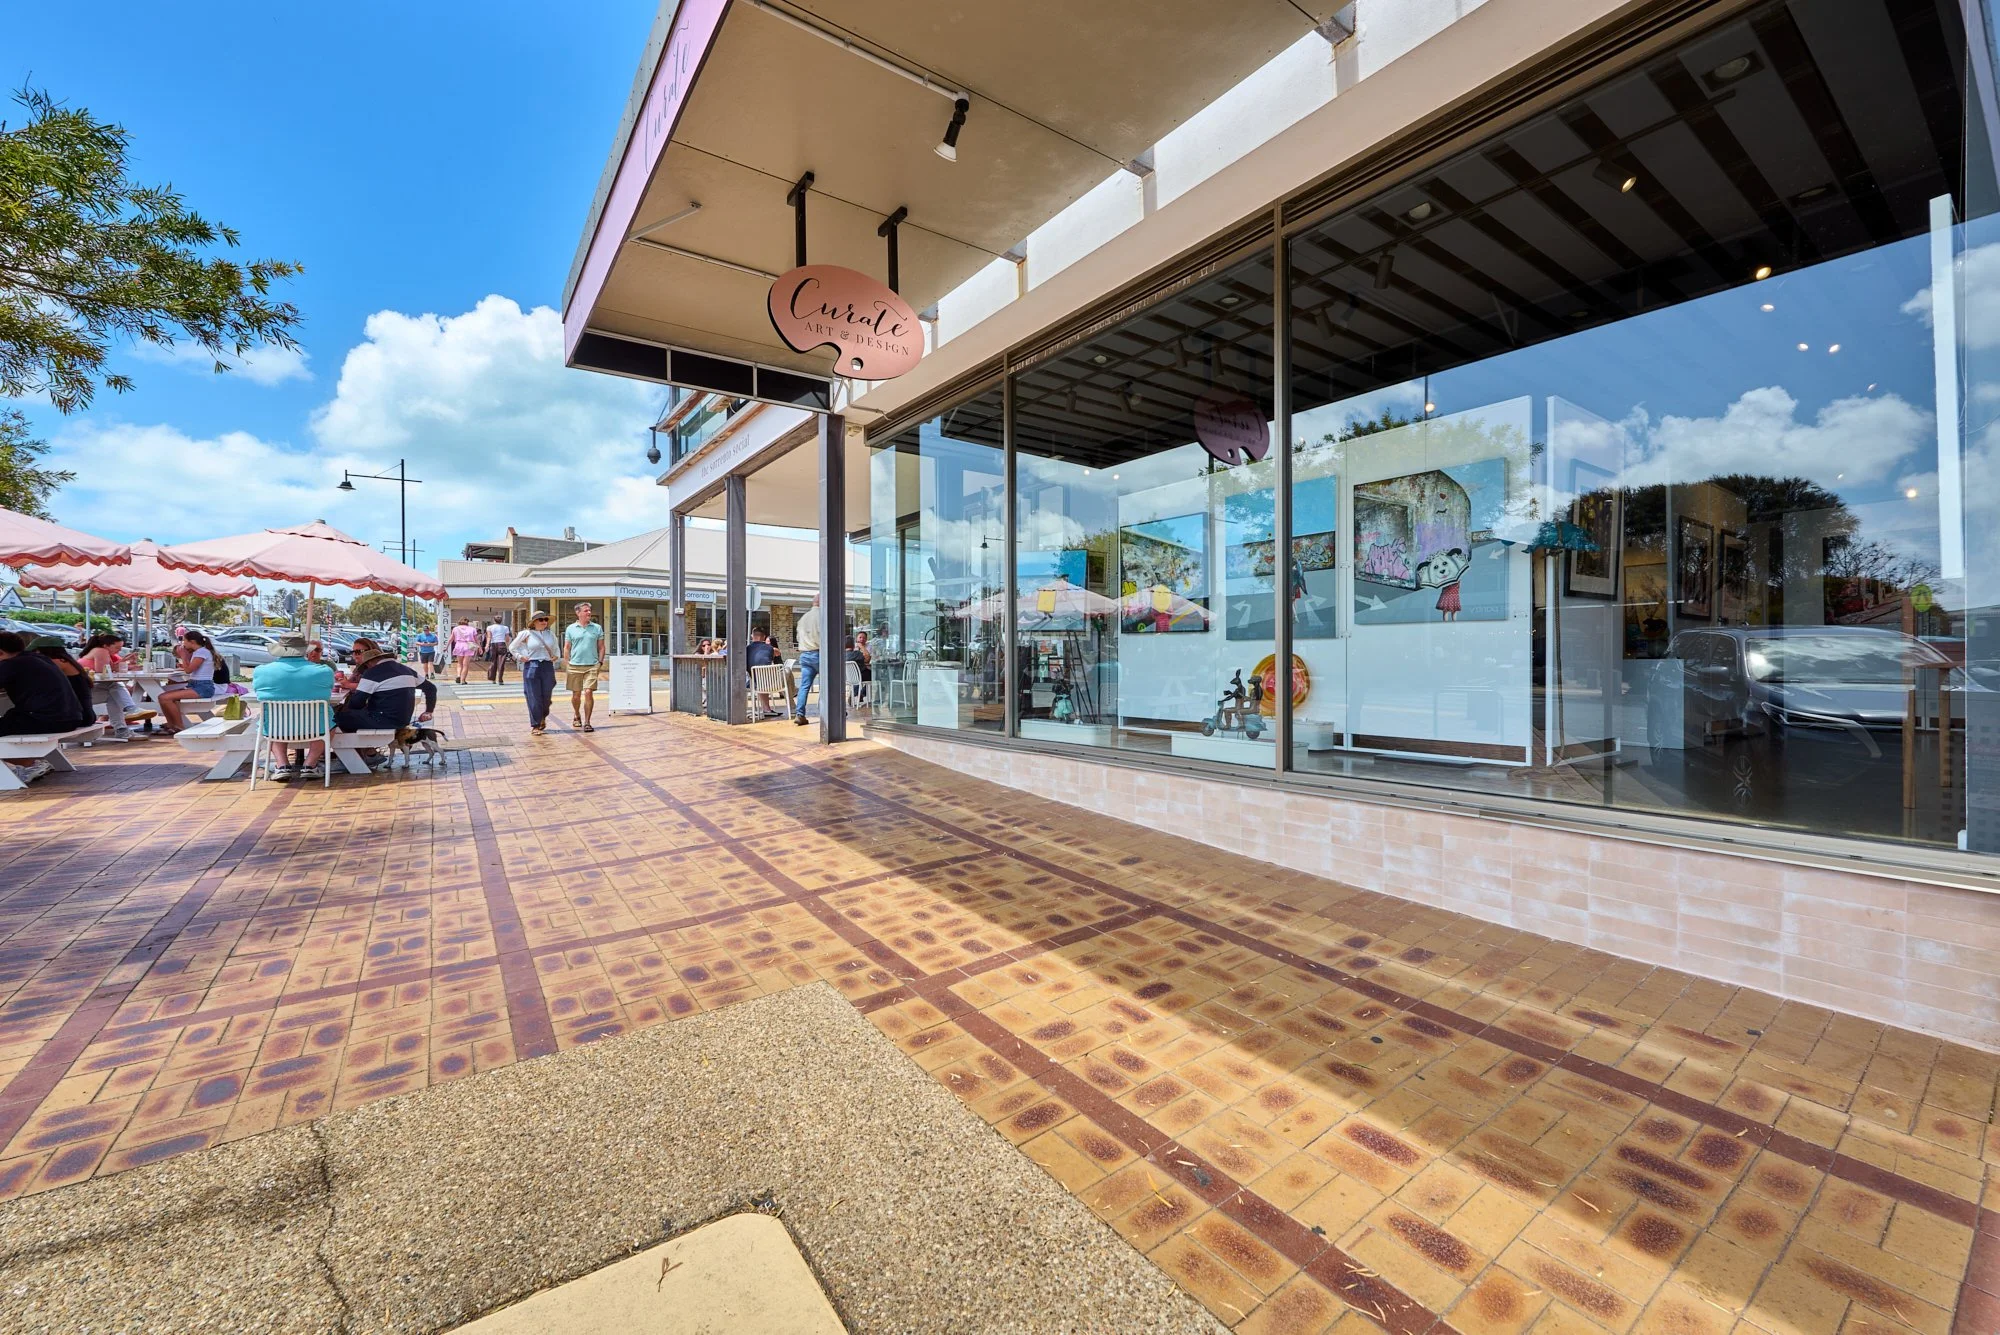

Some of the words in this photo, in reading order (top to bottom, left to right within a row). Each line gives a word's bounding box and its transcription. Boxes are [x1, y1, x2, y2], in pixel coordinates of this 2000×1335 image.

[790, 277, 909, 337] Curate
[804, 321, 834, 337] ART
[840, 330, 850, 340] &
[855, 334, 910, 356] DESIGN
